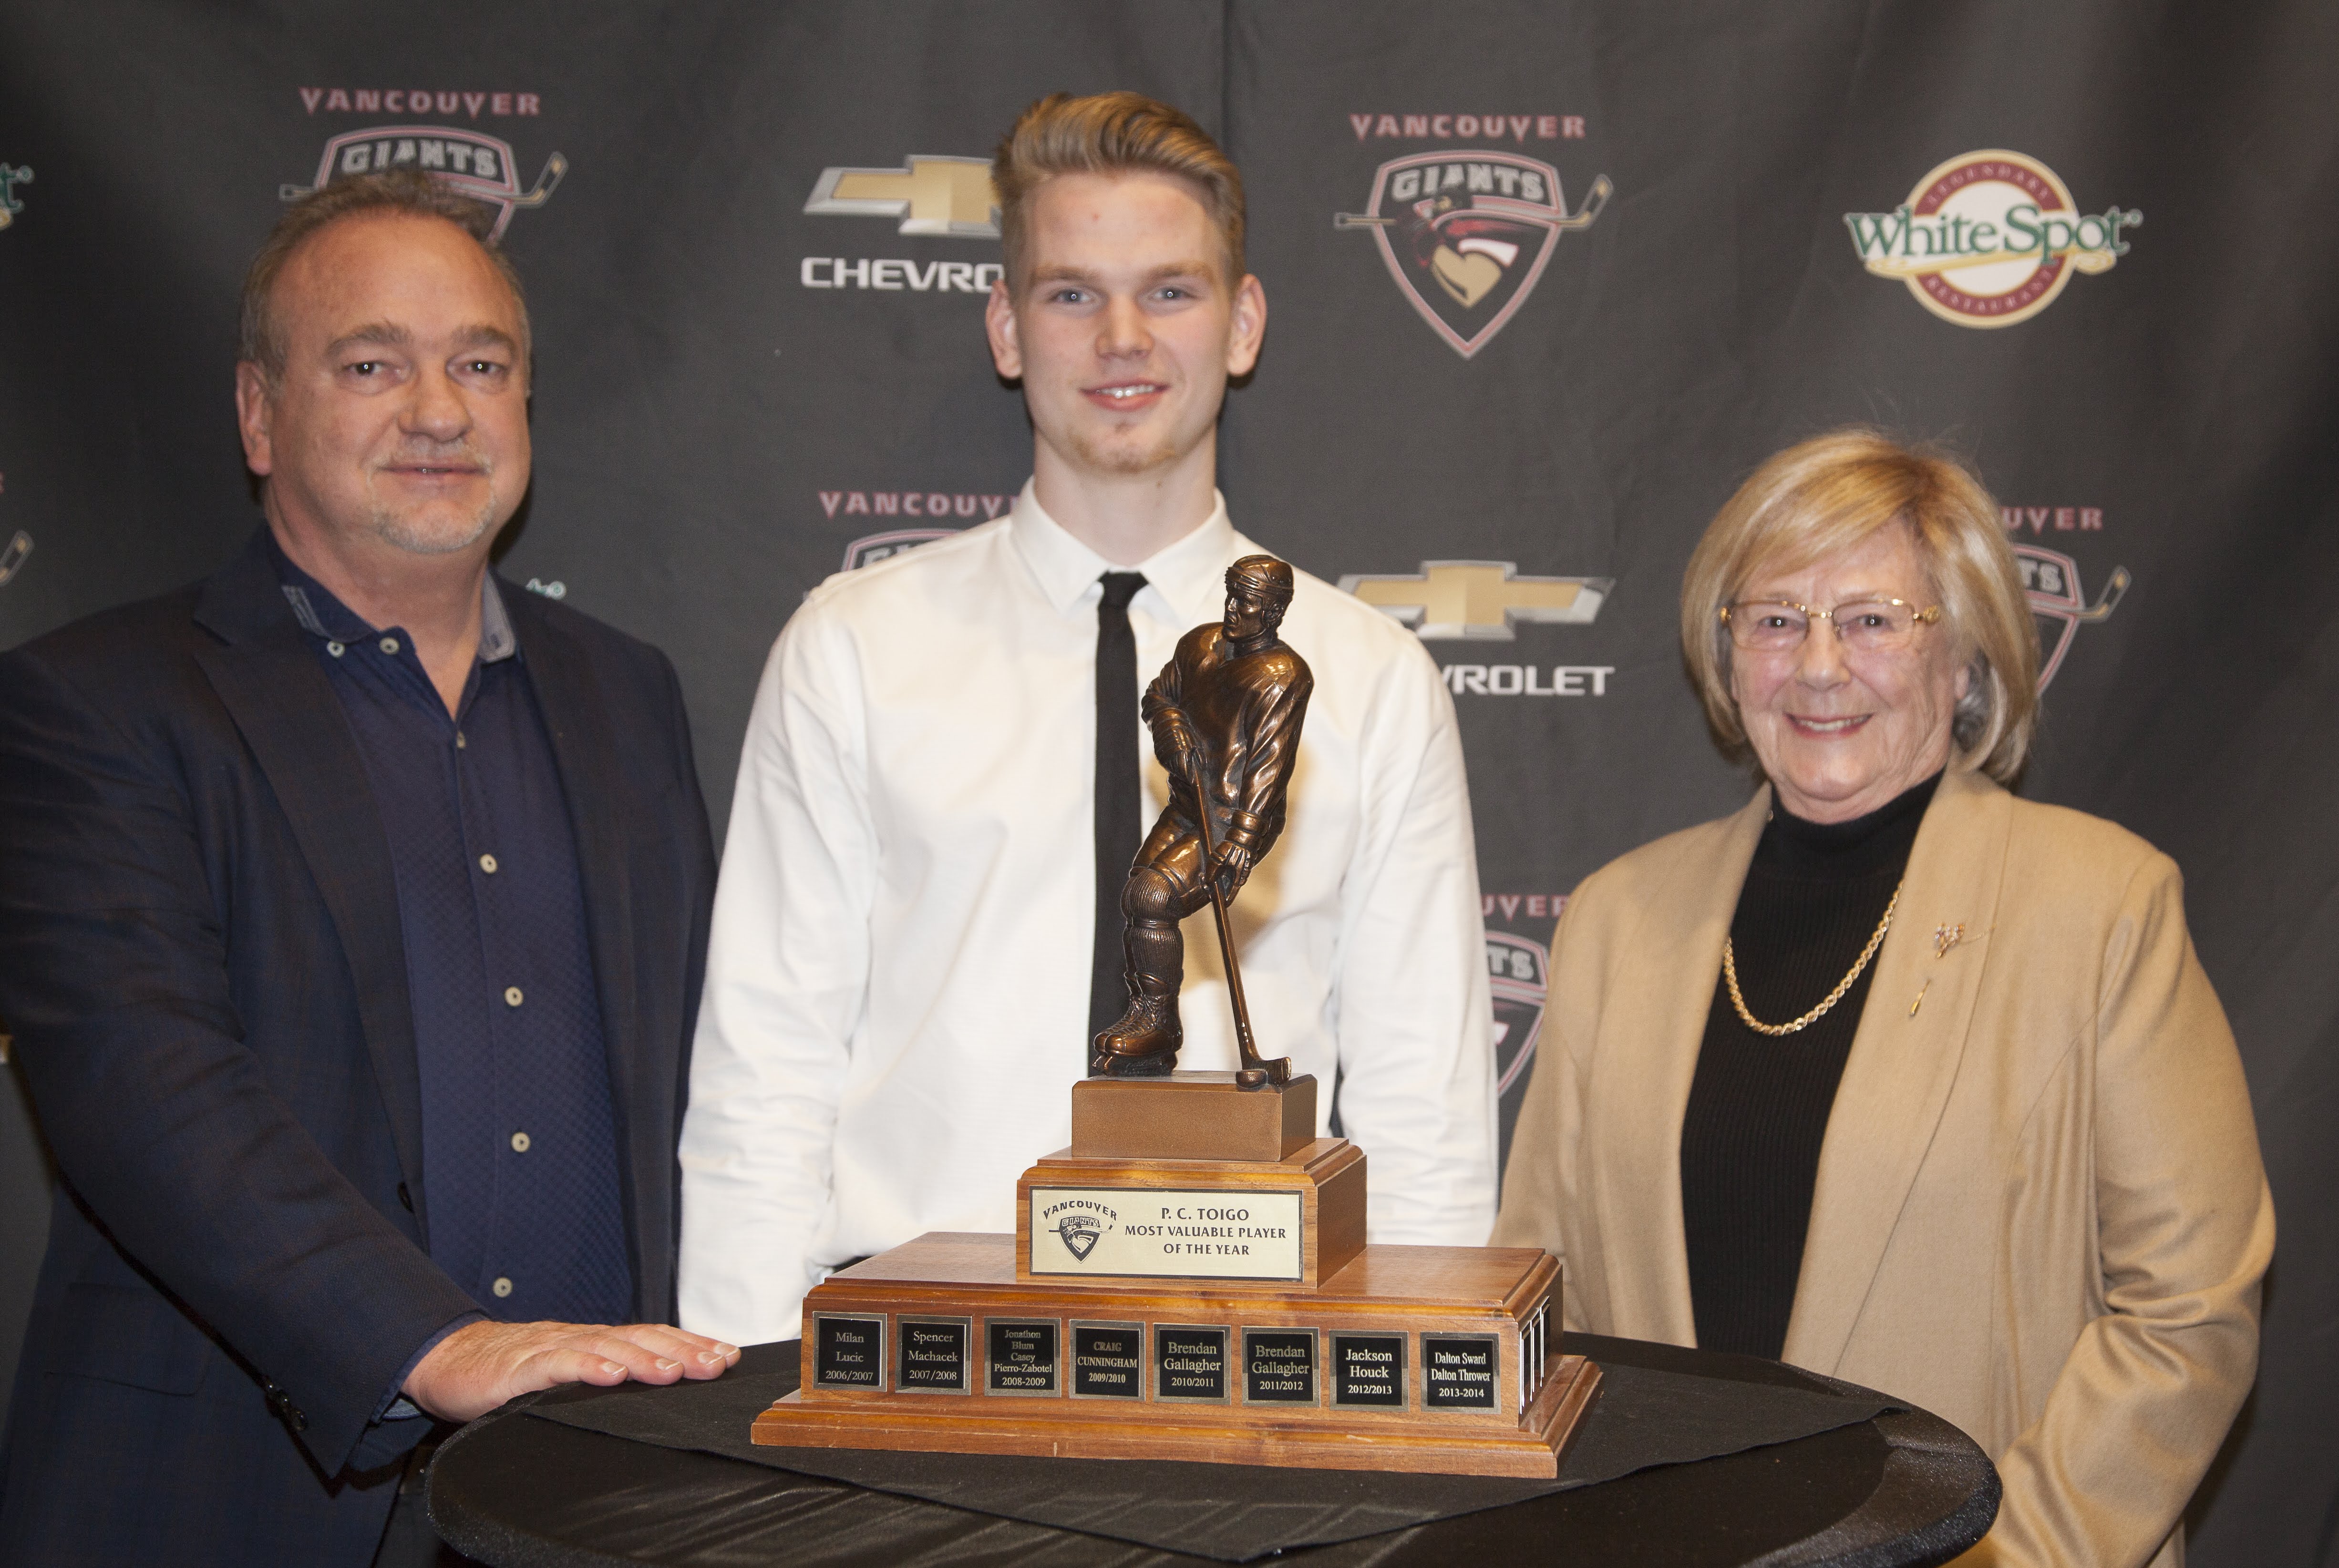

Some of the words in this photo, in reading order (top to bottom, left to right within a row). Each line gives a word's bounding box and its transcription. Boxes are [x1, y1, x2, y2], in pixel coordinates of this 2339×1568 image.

[298, 87, 541, 118] VANCOUVER
[1350, 113, 1587, 142] VANCOUVER
[341, 140, 498, 179] GIANTS
[1391, 163, 1545, 202] GIANTS
[1043, 1200, 1117, 1221] VANCOUVER
[1161, 1208, 1172, 1219] P.
[1177, 1208, 1192, 1220] C.
[1197, 1208, 1249, 1220] TOIGO
[1061, 1217, 1099, 1227] GIANTS
[1125, 1225, 1164, 1236] MOST
[1167, 1226, 1234, 1237] VALUABLE
[1238, 1228, 1286, 1239] PLAYER
[1163, 1243, 1181, 1254] OF
[1185, 1244, 1212, 1254] THE
[1216, 1245, 1250, 1255] YEAR
[835, 1332, 865, 1343] Milan
[913, 1331, 954, 1344] Spencer
[1005, 1330, 1041, 1339] Jonathon
[1011, 1341, 1034, 1350] Blum
[1093, 1342, 1122, 1352] CRAIG
[1168, 1342, 1217, 1355] Brendan
[1255, 1345, 1306, 1358] Brendan
[835, 1351, 864, 1362] Lucic
[908, 1350, 958, 1362] Machacek
[1346, 1349, 1393, 1362] Jackson
[1434, 1352, 1461, 1364] Dalton
[1462, 1352, 1487, 1365] Sward
[1077, 1356, 1138, 1368] CUNNINGHAM
[1164, 1358, 1221, 1373] Gallagher
[825, 1370, 874, 1381] 2006/2007
[909, 1370, 957, 1381] 2007/2008
[1252, 1362, 1309, 1377] Gallagher
[1349, 1366, 1390, 1378] Houck
[1431, 1368, 1457, 1381] Dalton
[1458, 1369, 1491, 1382] Thrower
[1002, 1377, 1046, 1386] 2008-2009
[1088, 1373, 1126, 1384] 2009/2010
[1171, 1377, 1214, 1387] 2010/2011
[1259, 1381, 1304, 1391] 2011/2012
[1348, 1384, 1392, 1394] 2012/2013
[1439, 1387, 1485, 1398] 2013-2014
